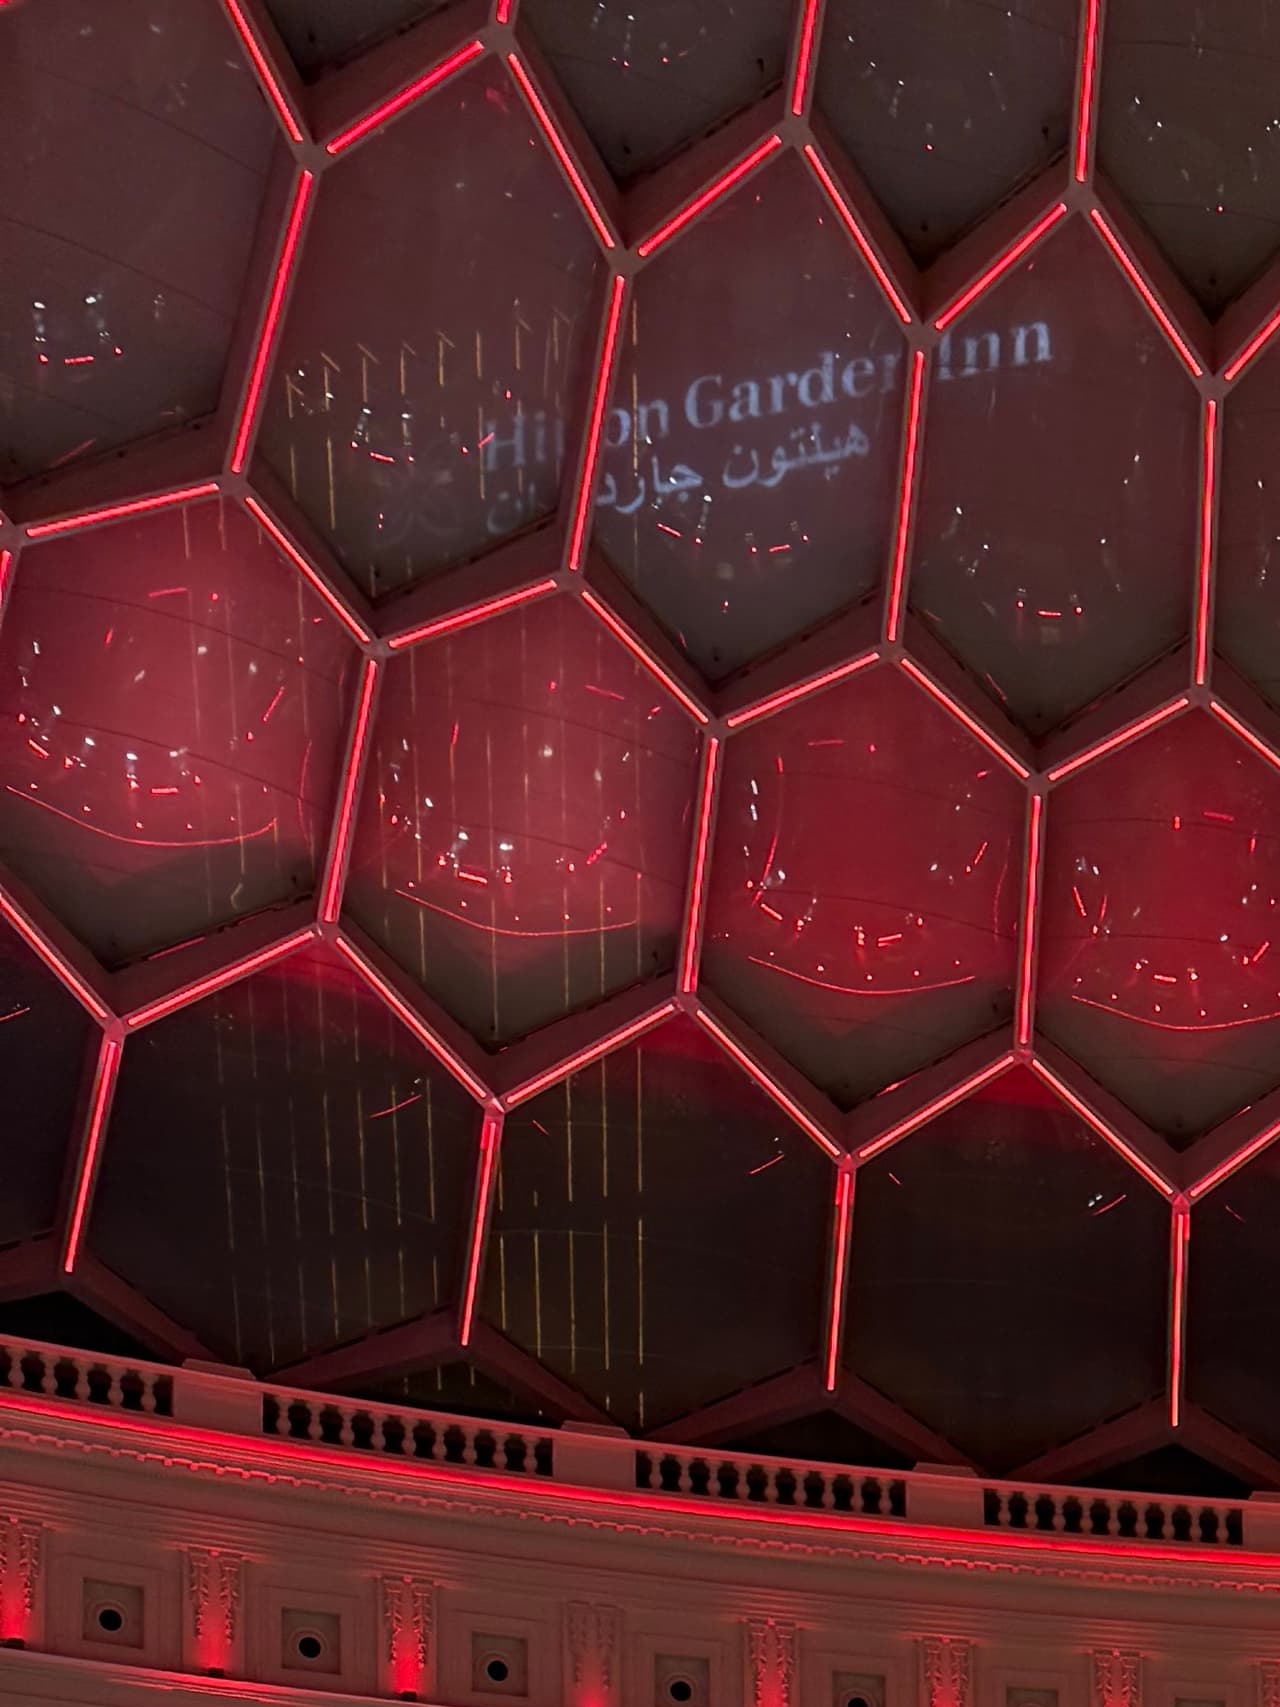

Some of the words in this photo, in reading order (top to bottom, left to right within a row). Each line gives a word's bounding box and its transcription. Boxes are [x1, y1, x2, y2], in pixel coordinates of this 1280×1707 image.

[485, 399, 670, 471] Hilon
[936, 320, 1053, 381] Inn
[722, 420, 870, 488] هيلتون
